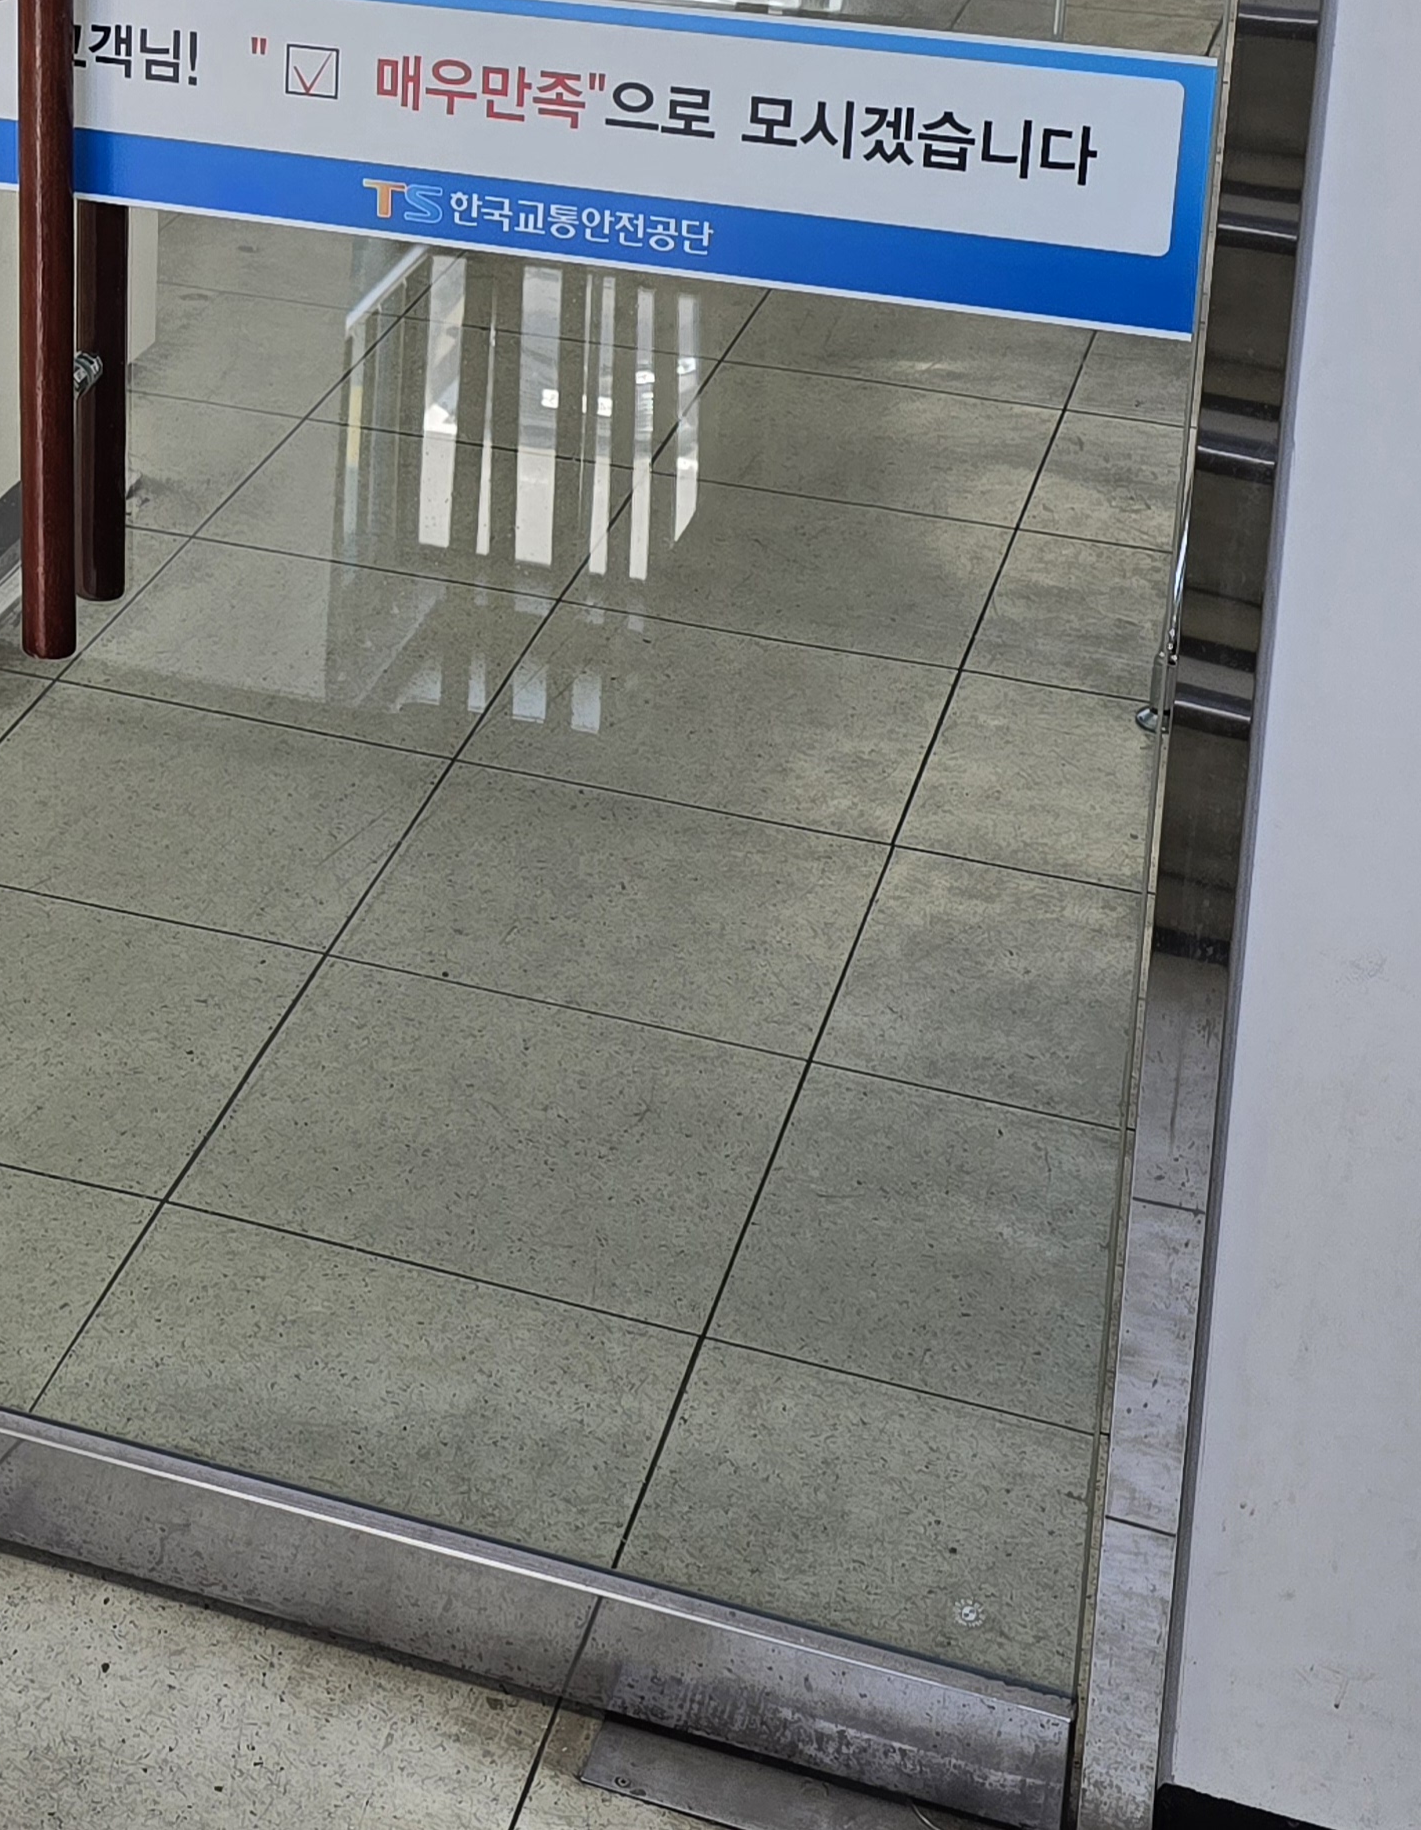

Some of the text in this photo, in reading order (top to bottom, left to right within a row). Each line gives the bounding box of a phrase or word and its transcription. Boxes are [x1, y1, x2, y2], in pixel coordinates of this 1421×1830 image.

[740, 93, 1098, 187] 모시겠습니다
[363, 178, 714, 257] TS 한국교통안전공단
